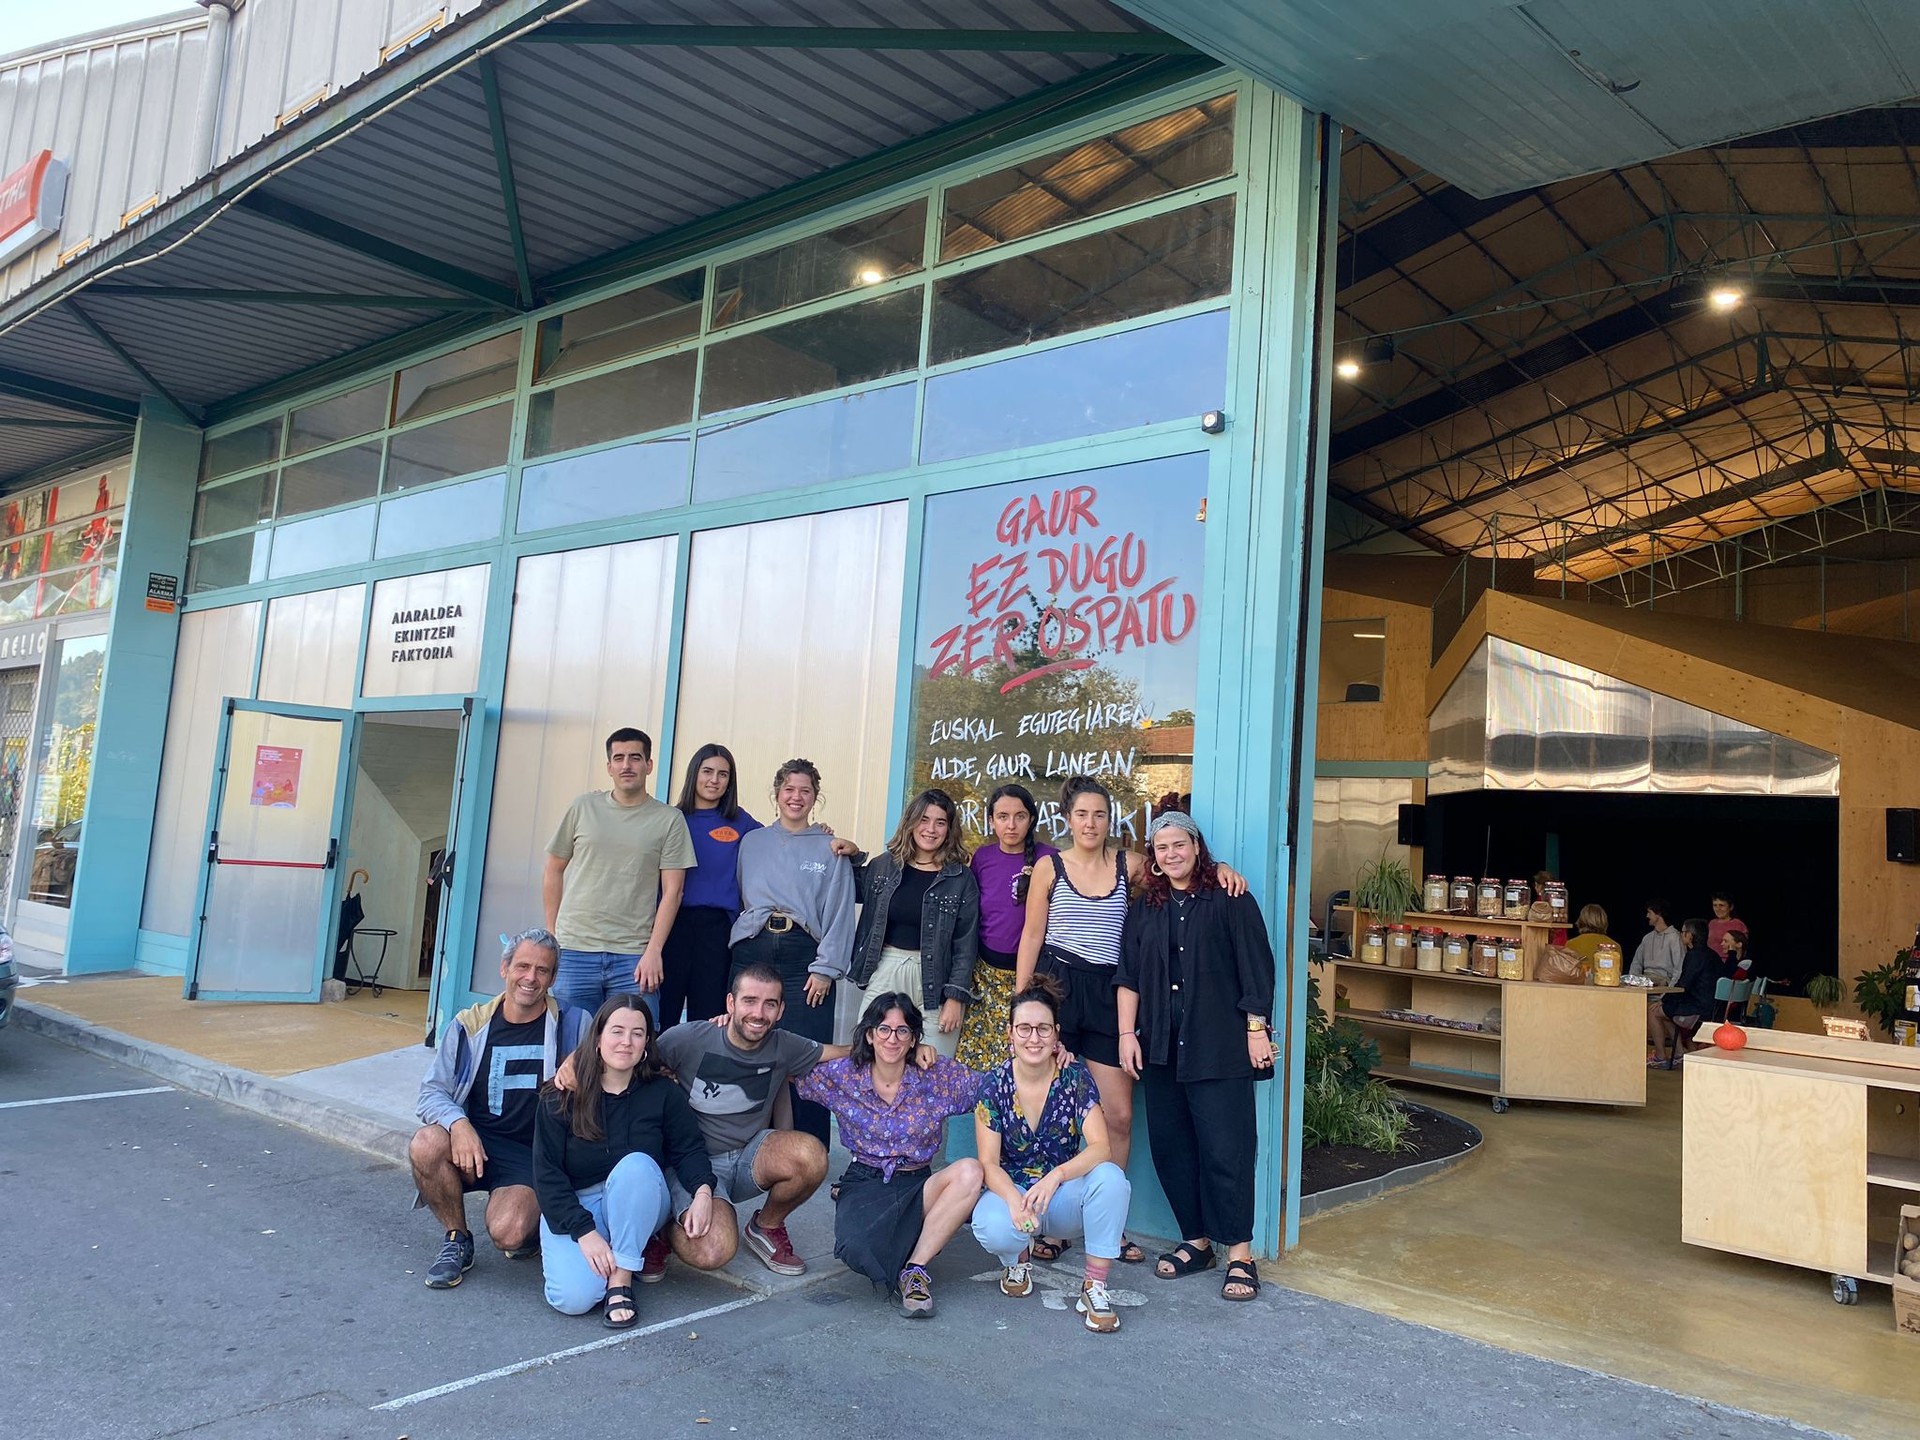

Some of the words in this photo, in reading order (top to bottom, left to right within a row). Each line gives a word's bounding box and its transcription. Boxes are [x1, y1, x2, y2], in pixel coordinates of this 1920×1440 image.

[996, 485, 1100, 547] GAUR
[965, 550, 1030, 617] EZ
[1038, 532, 1147, 594] DUGU
[149, 588, 175, 598] ALARMA
[391, 604, 462, 625] AIARALDEA
[394, 625, 455, 643] EKINTZEN
[391, 645, 454, 663] FAKTORIA
[929, 717, 1005, 746] EUSKAL
[931, 755, 982, 787] ALDE,
[986, 751, 1037, 782] GAUR
[1045, 746, 1136, 778] LANEAN
